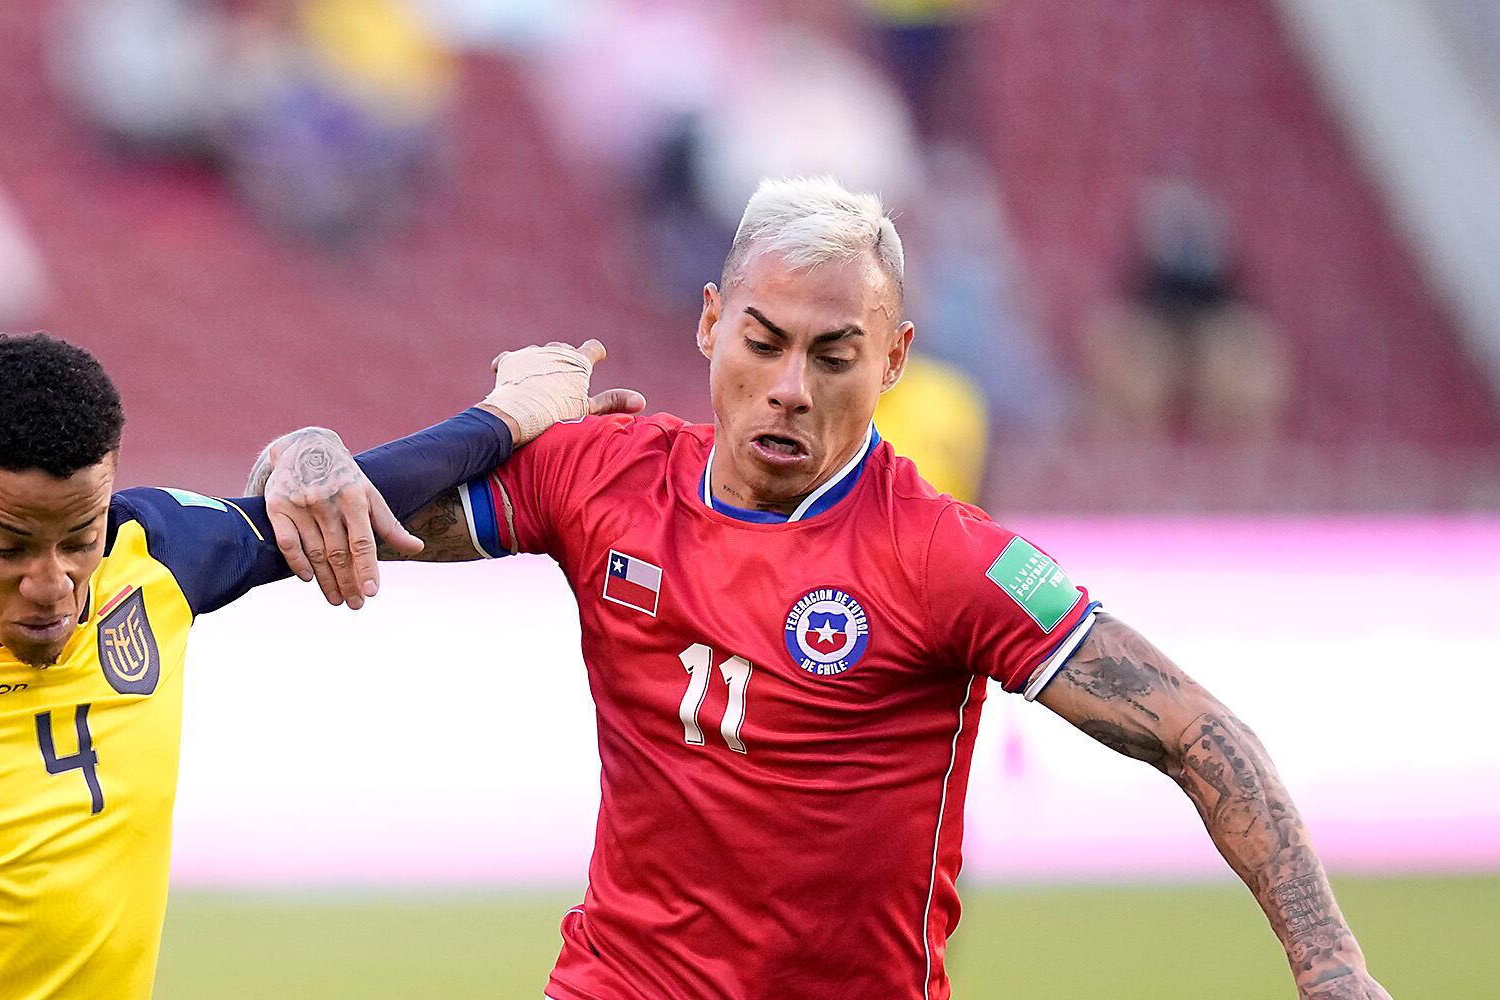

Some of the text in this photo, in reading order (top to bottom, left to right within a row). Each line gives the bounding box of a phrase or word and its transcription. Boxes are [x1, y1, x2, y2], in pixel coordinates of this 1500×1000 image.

[785, 589, 869, 637] FEDERACION DE FUTBOL
[678, 642, 753, 755] 11
[800, 658, 848, 676] DE CHILE
[34, 702, 105, 816] 4
